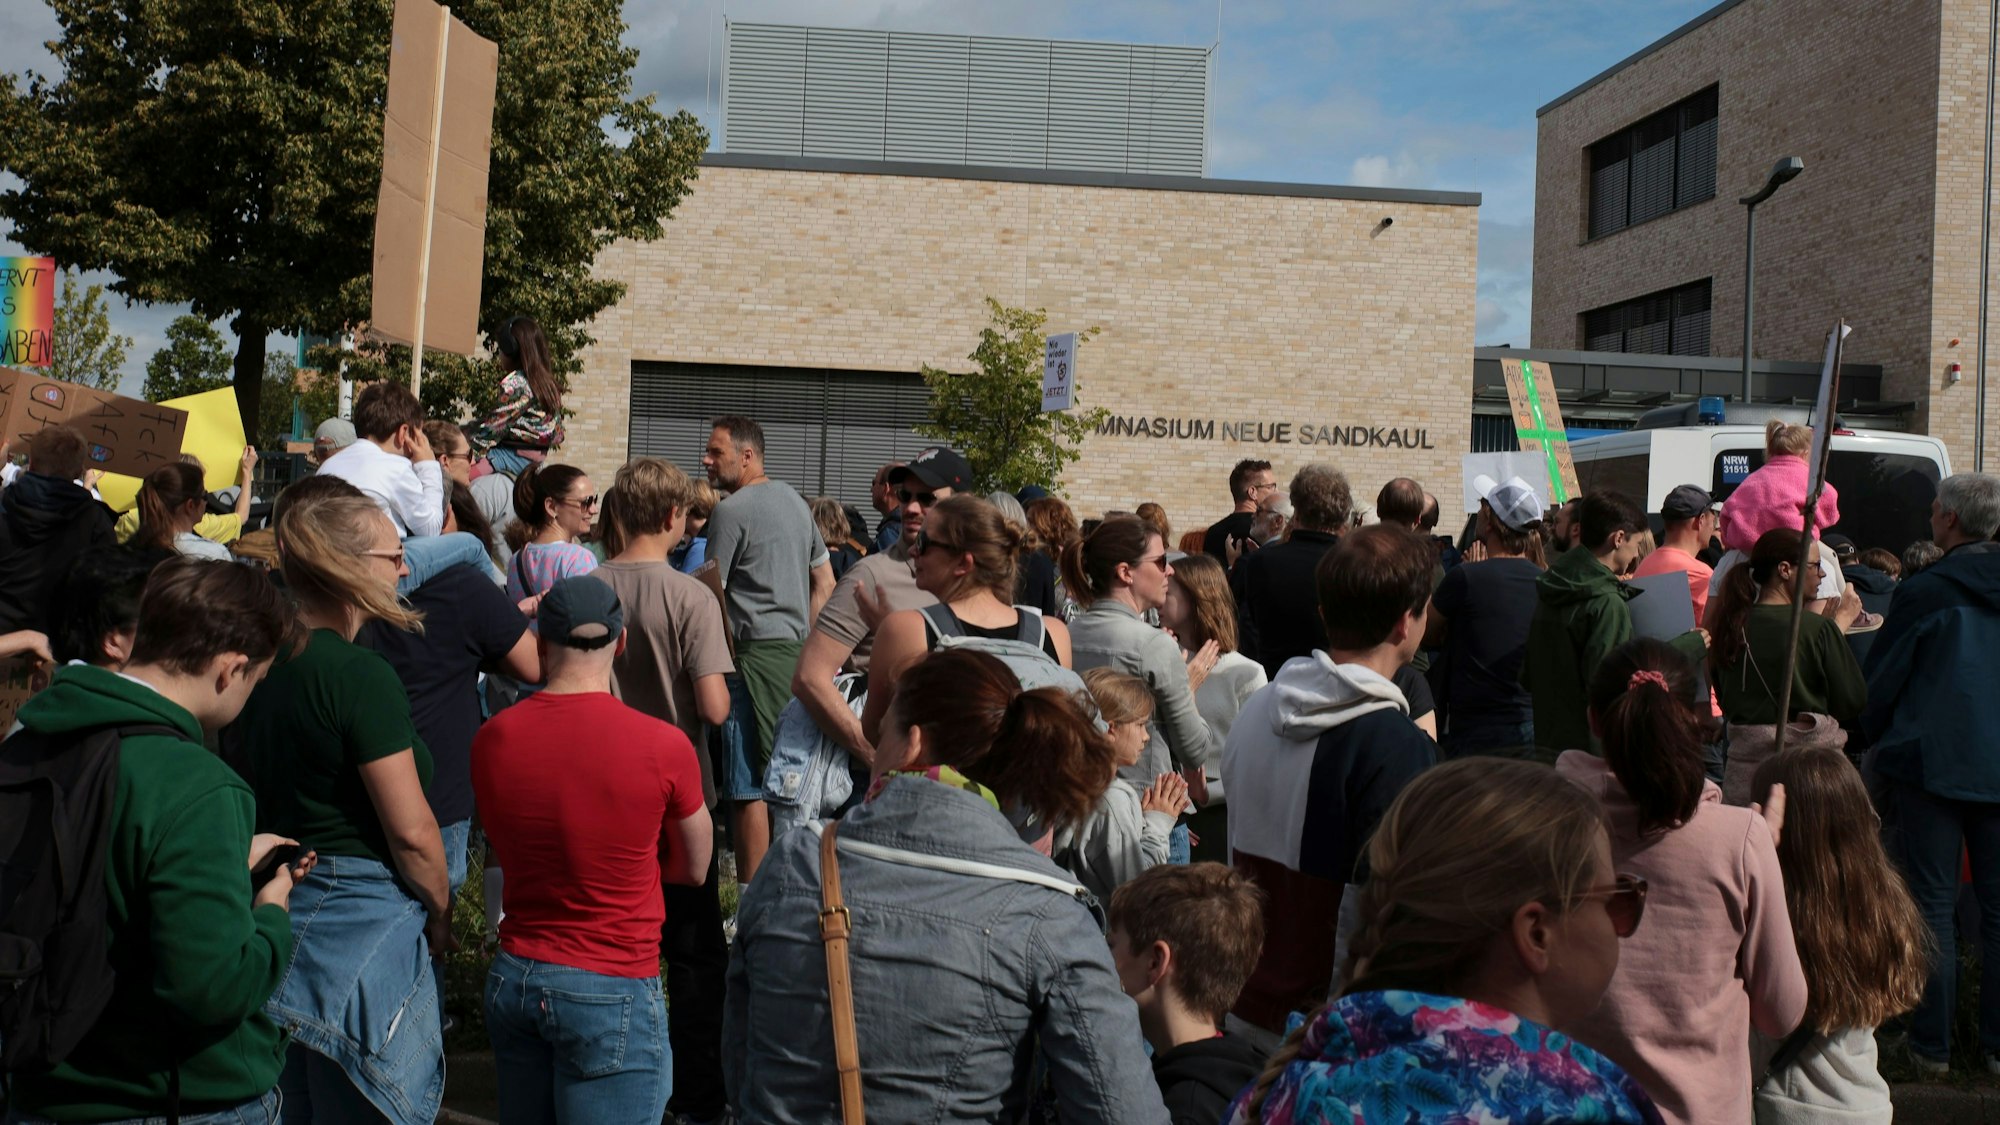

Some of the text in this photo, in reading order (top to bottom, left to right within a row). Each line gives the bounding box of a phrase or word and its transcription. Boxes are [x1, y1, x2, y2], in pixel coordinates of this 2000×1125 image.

[1049, 340, 1058, 349] Nie
[1048, 349, 1067, 358] wieder
[1221, 421, 1293, 444] NEUE
[1298, 424, 1435, 450] SANDKAUL
[1723, 455, 1748, 465] NRW
[1723, 465, 1749, 474] 31513
